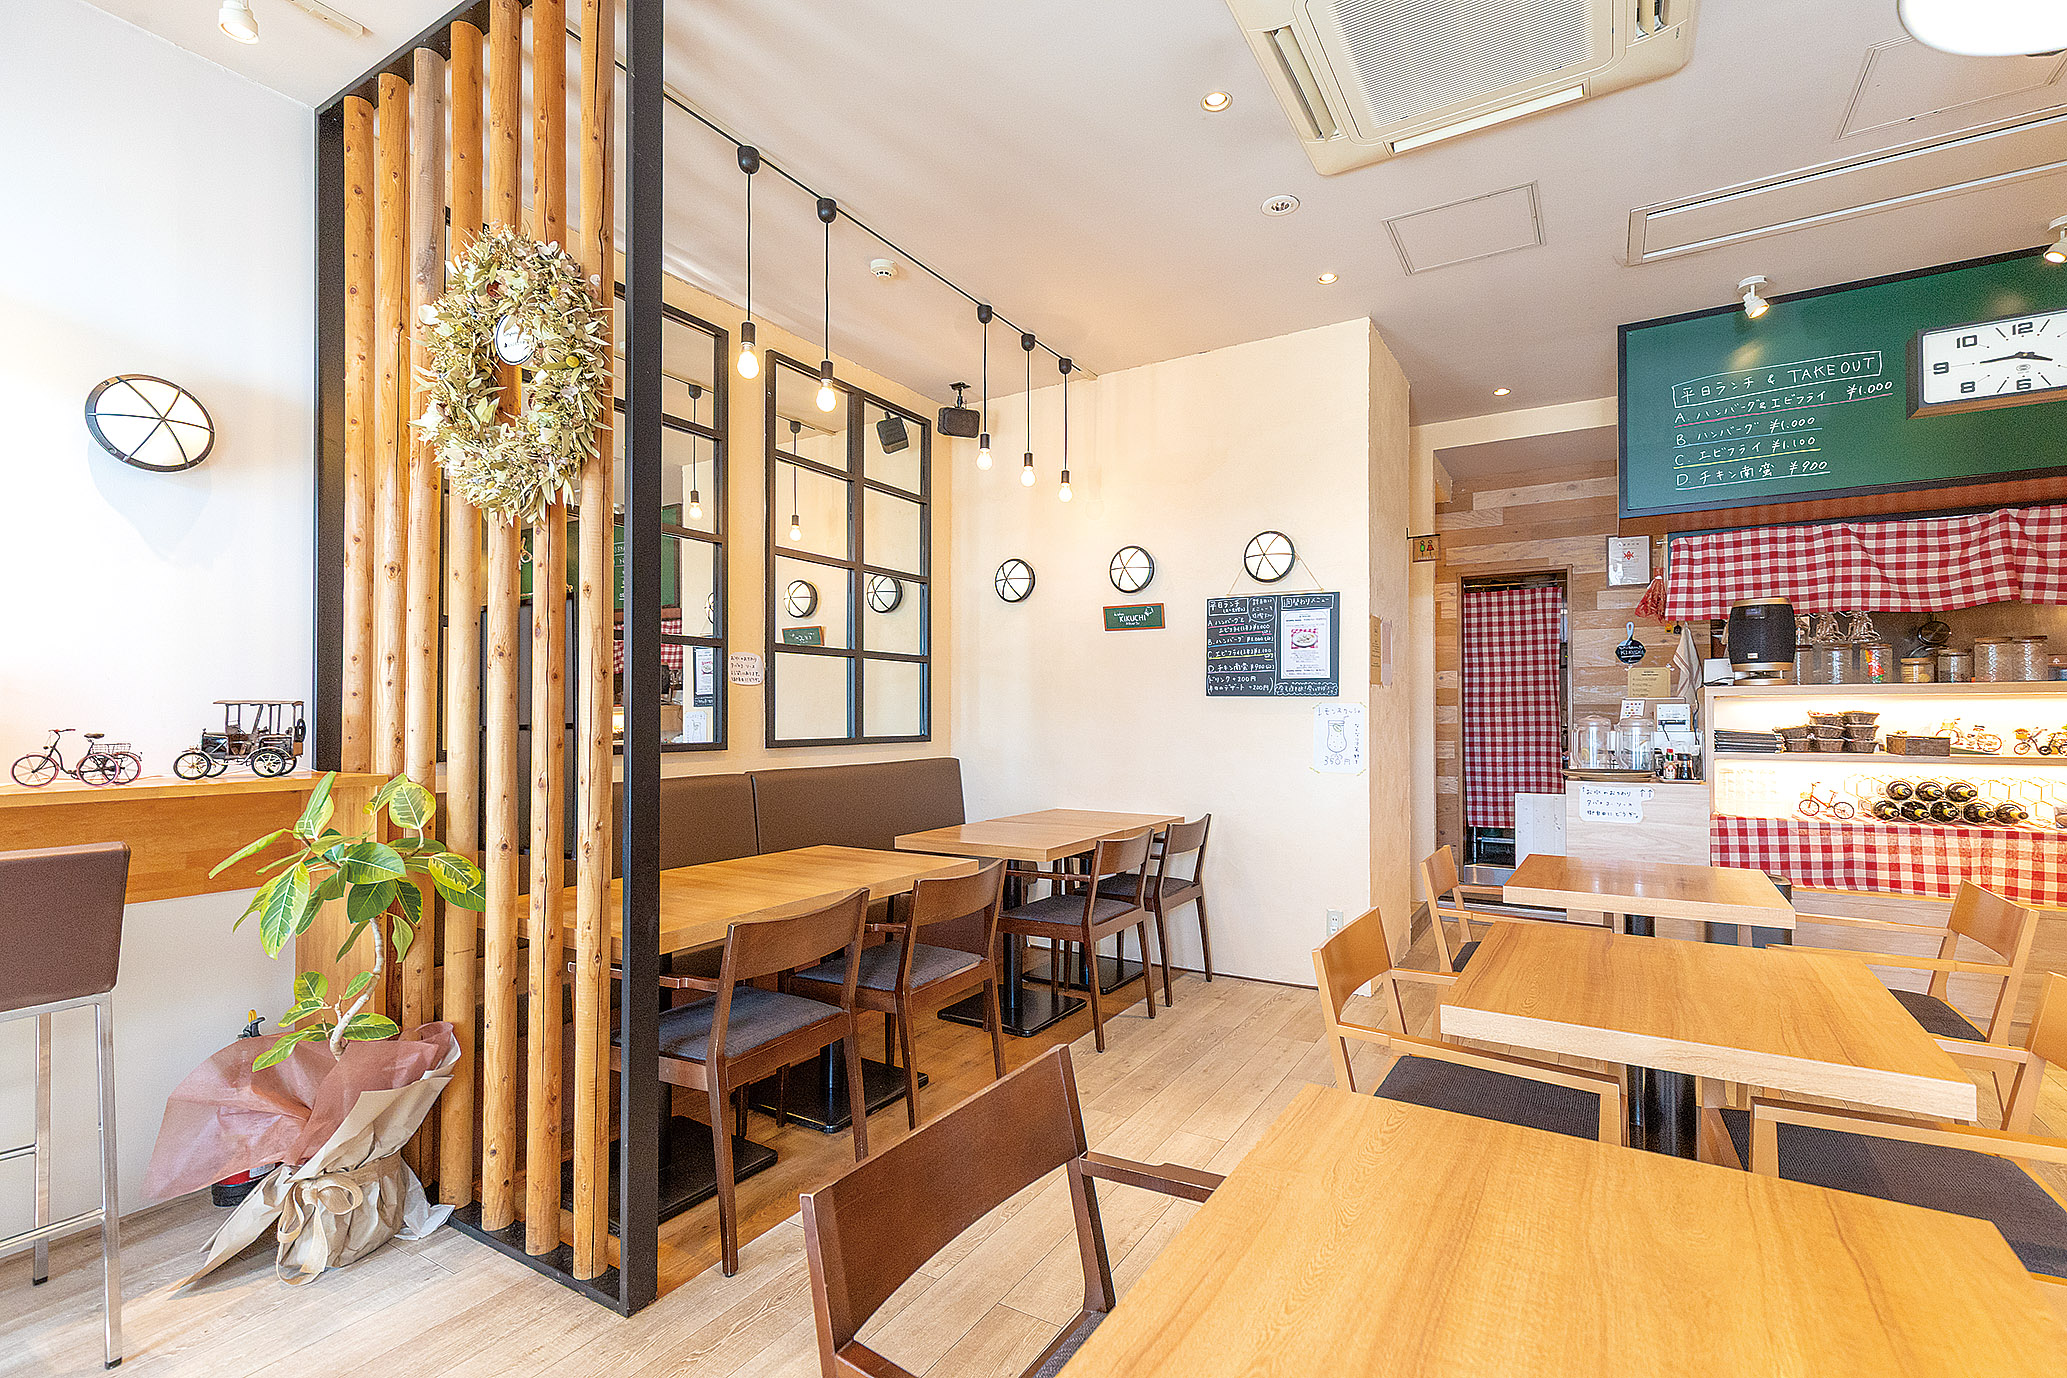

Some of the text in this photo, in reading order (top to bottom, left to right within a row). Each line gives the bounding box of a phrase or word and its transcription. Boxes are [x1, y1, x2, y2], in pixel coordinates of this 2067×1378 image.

[2012, 321, 2033, 336] 12
[1956, 334, 1978, 349] 10
[1933, 361, 1949, 375] 9
[1681, 376, 1755, 403] 平日ランチ
[1960, 381, 1976, 394] 8
[2016, 378, 2032, 391] 6
